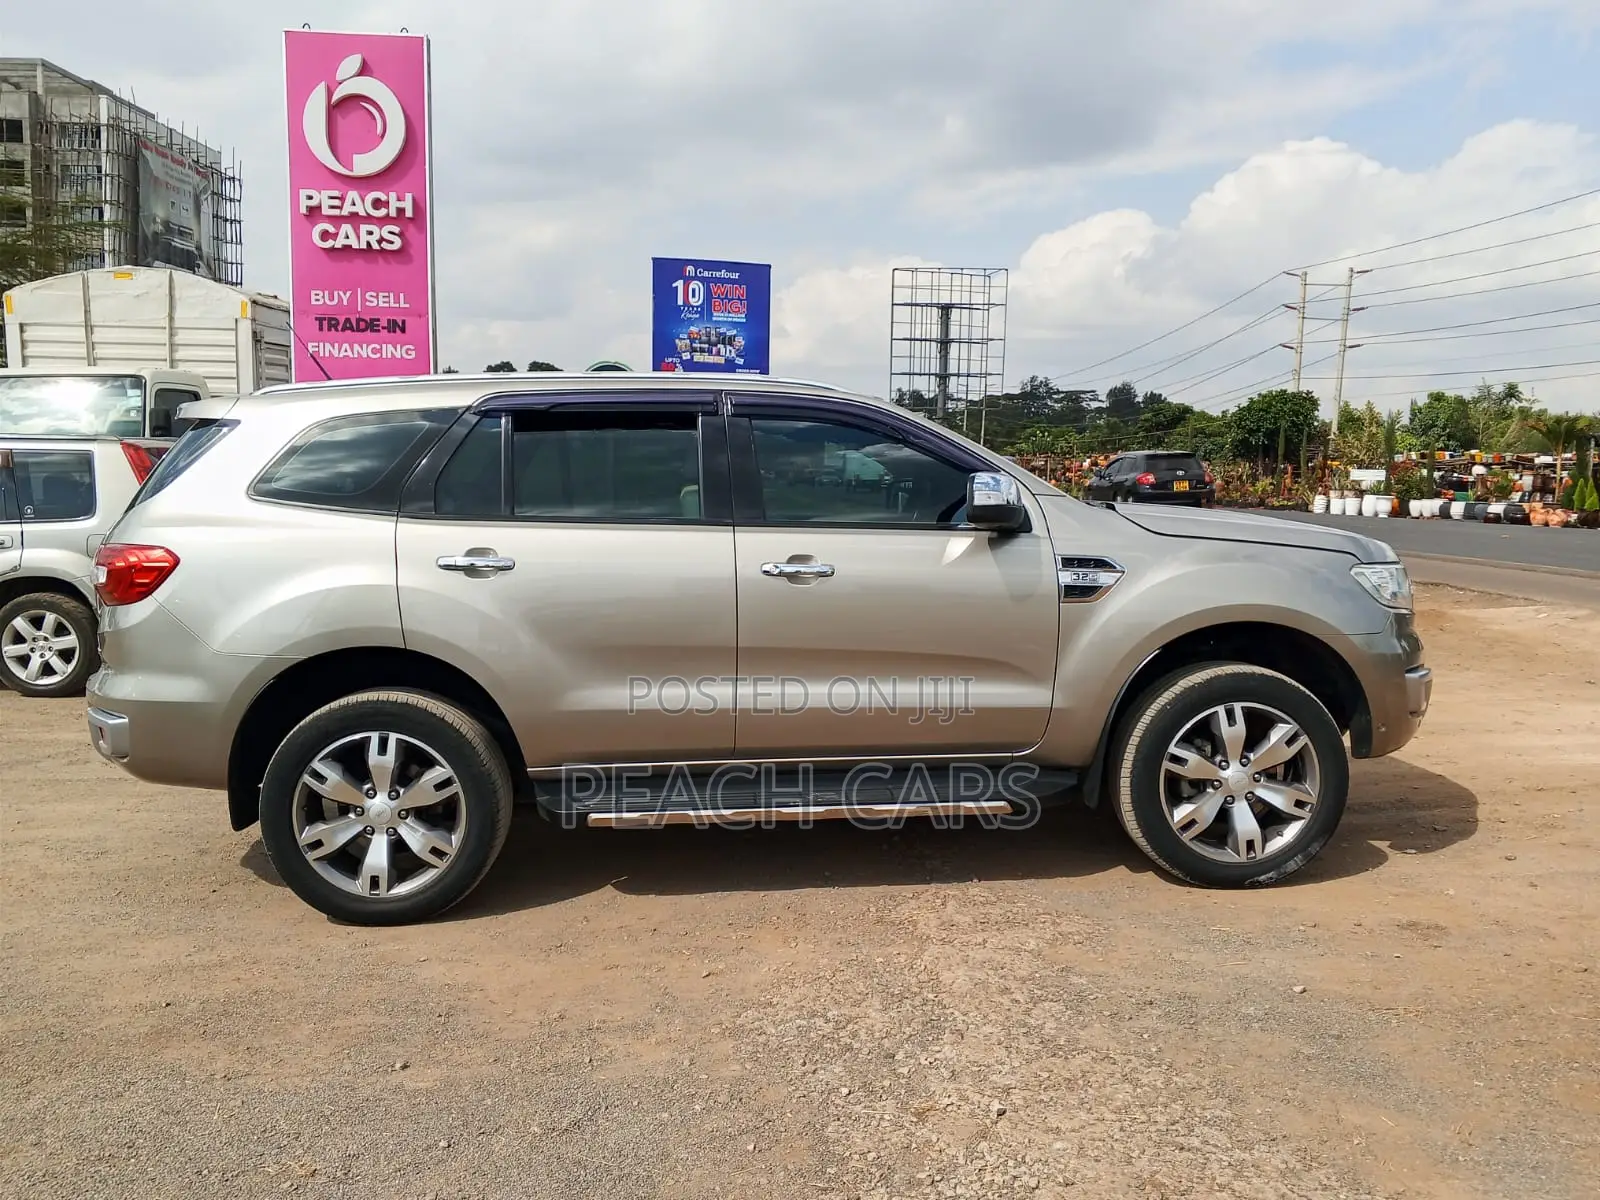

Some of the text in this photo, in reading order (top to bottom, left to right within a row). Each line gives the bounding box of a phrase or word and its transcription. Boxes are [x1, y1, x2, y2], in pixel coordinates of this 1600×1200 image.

[299, 189, 413, 219] PEACH
[311, 223, 403, 251] CARS
[697, 268, 740, 279] Carrefour
[310, 289, 410, 309] BUY SELL
[672, 279, 704, 306] 10
[710, 283, 746, 299] WIN
[711, 299, 747, 314] BIG!
[314, 315, 407, 334] TRADE-IN
[308, 342, 416, 359] FINANCING
